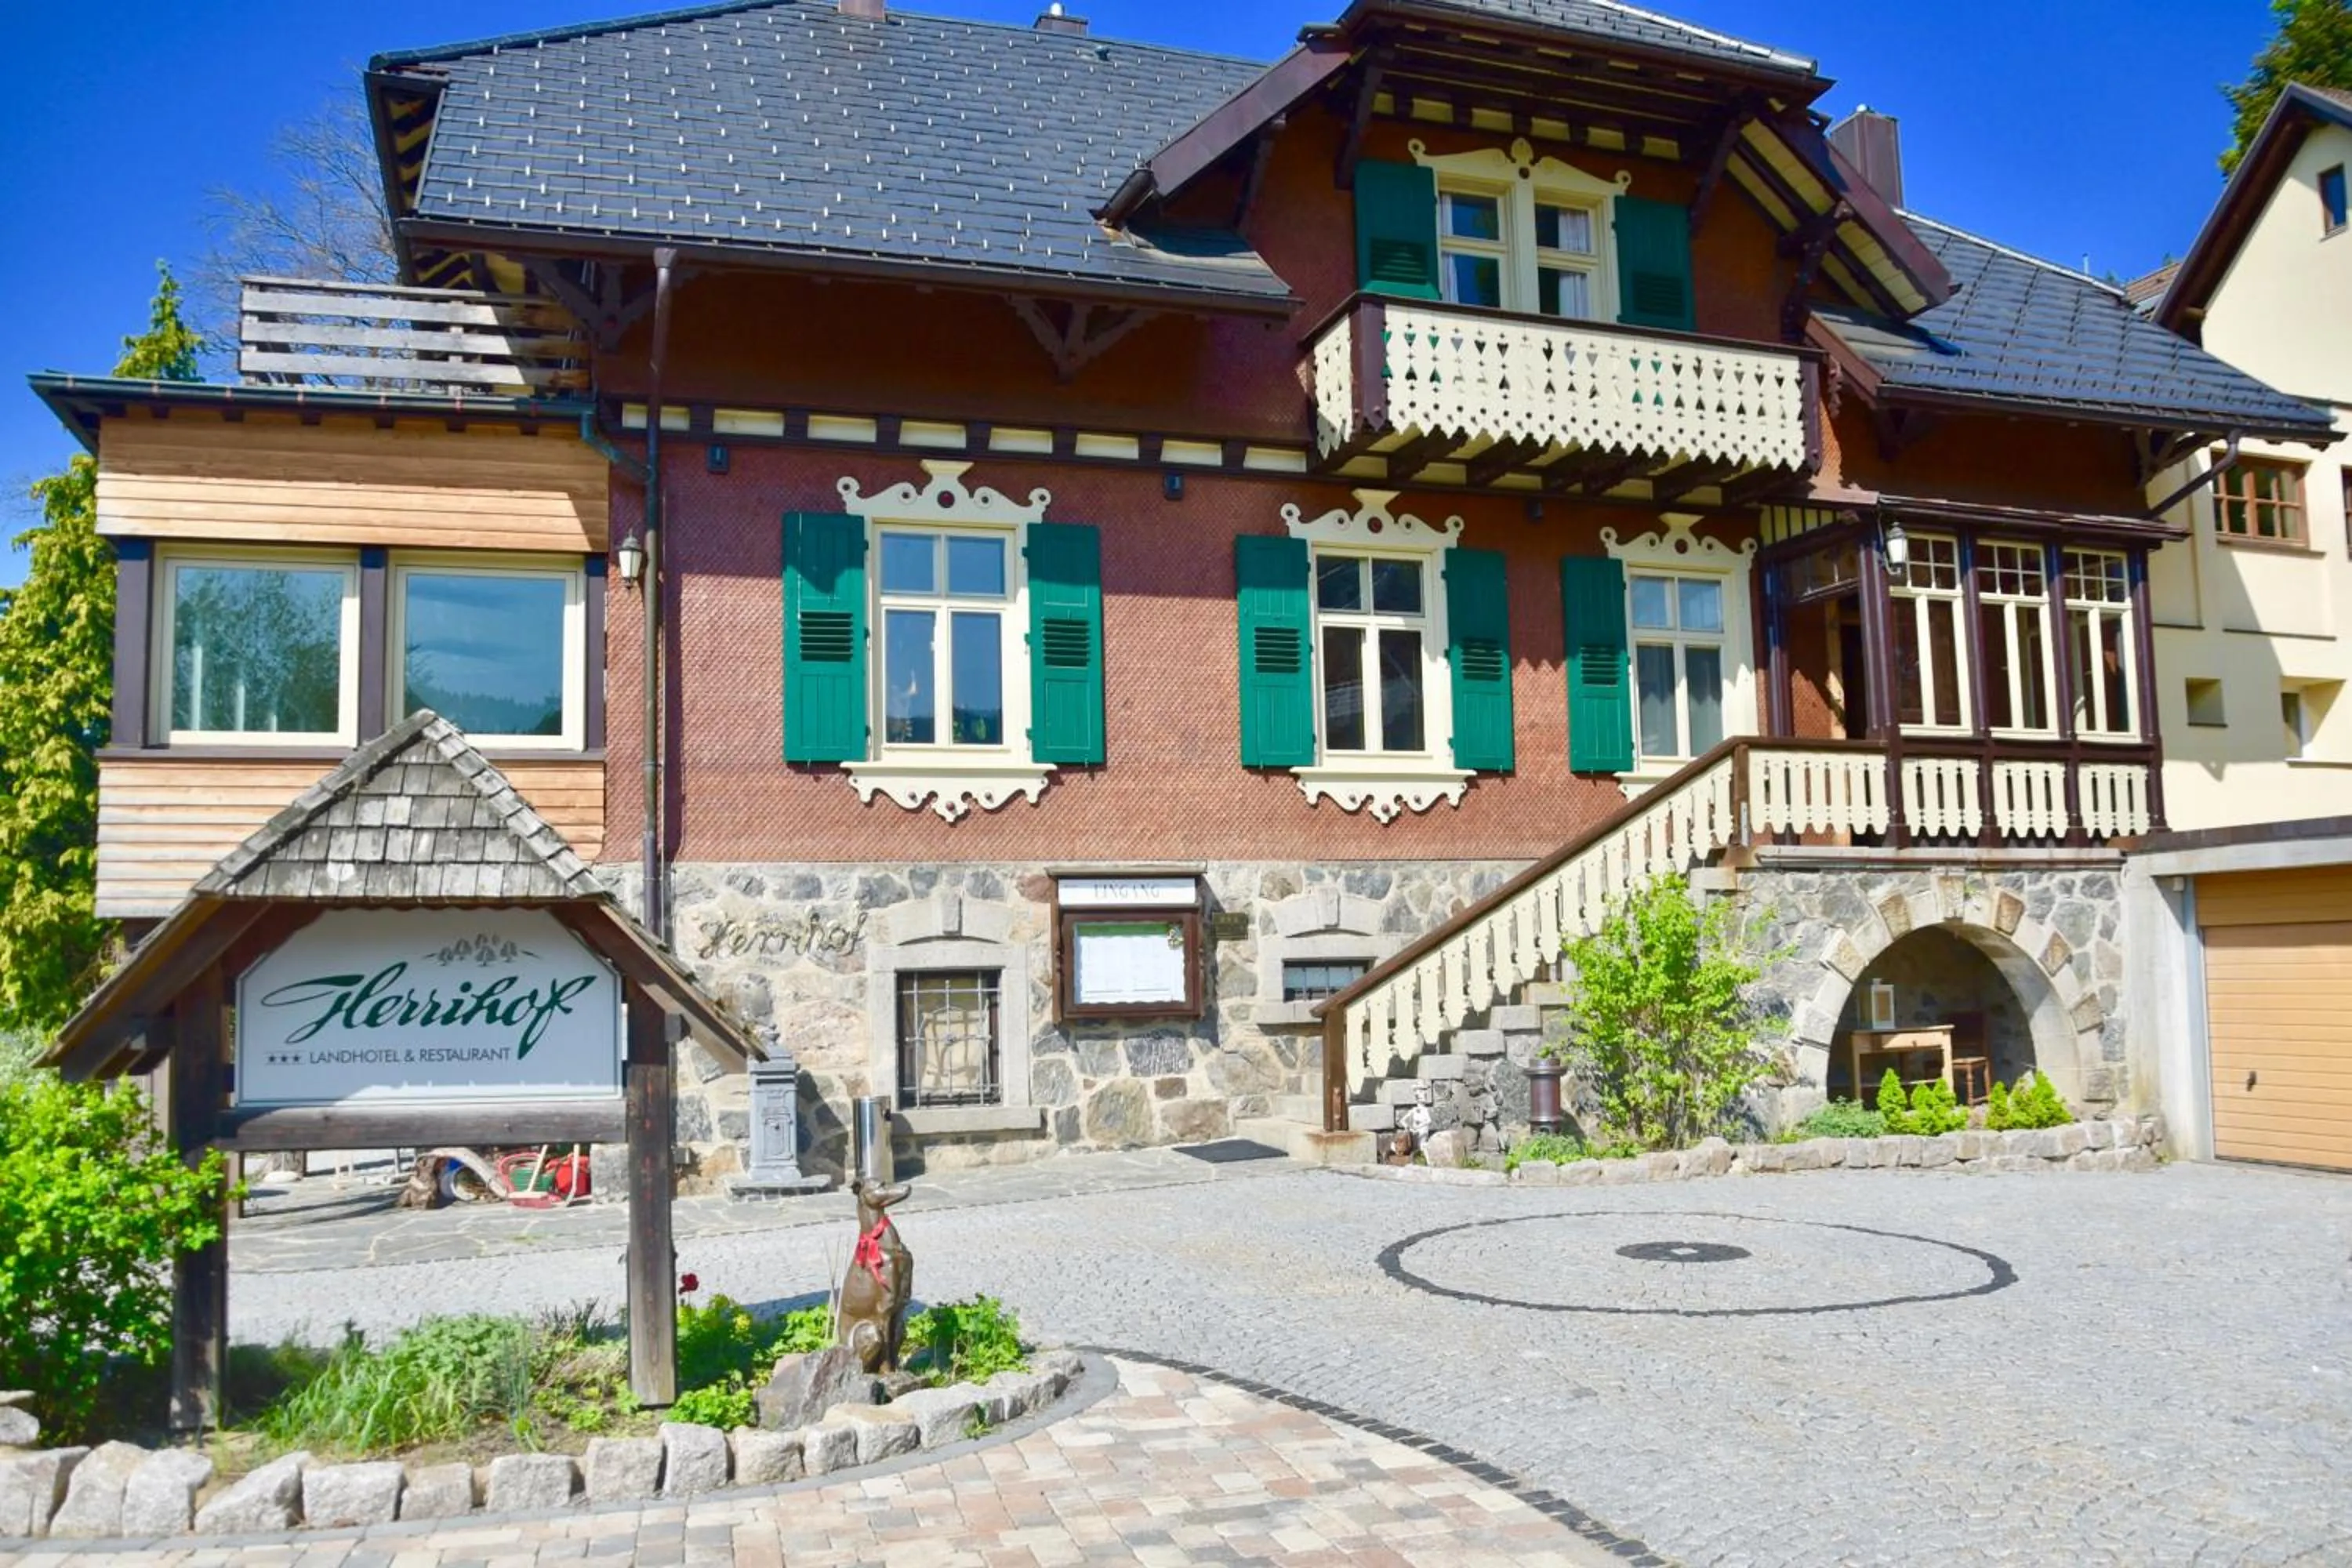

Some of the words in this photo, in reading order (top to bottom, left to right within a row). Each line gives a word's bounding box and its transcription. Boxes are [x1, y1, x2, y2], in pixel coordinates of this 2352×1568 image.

[260, 961, 597, 1060] Herrihof
[310, 1048, 400, 1064] LANDHOTEL
[404, 1048, 415, 1062] &
[419, 1047, 510, 1062] RESTAURANT
